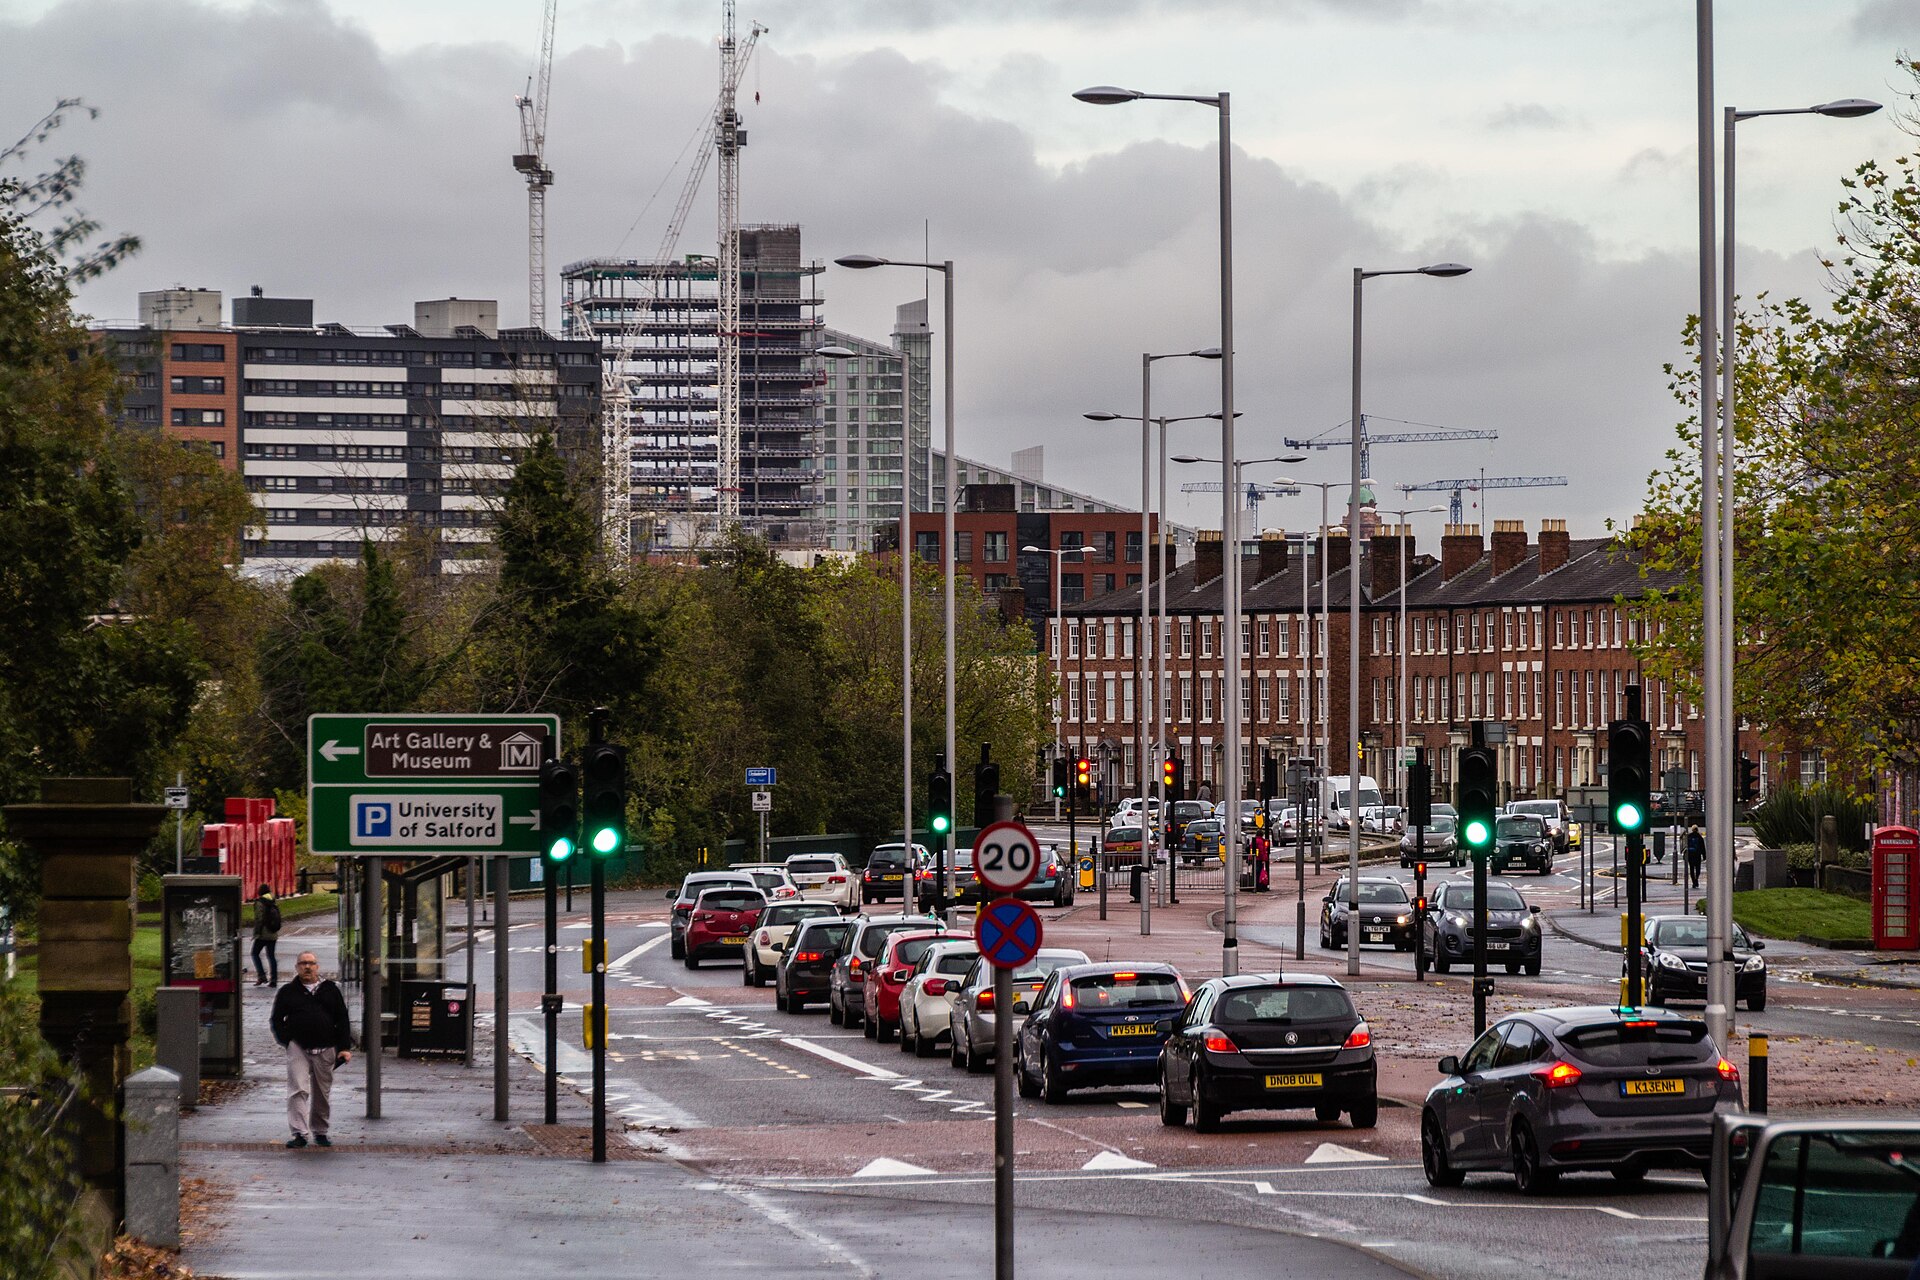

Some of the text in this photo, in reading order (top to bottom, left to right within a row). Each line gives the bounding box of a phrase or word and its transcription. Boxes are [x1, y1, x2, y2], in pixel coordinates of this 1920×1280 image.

[371, 732, 492, 752] Art Gallery &
[392, 753, 471, 769] Museum
[399, 802, 496, 820] University
[365, 806, 387, 835] P
[399, 823, 496, 838] of Salford
[983, 843, 1030, 871] 20
[1112, 1025, 1136, 1035] WV59
[1270, 1074, 1318, 1086] DN08 OUL
[1634, 1081, 1676, 1093] K13ENH
